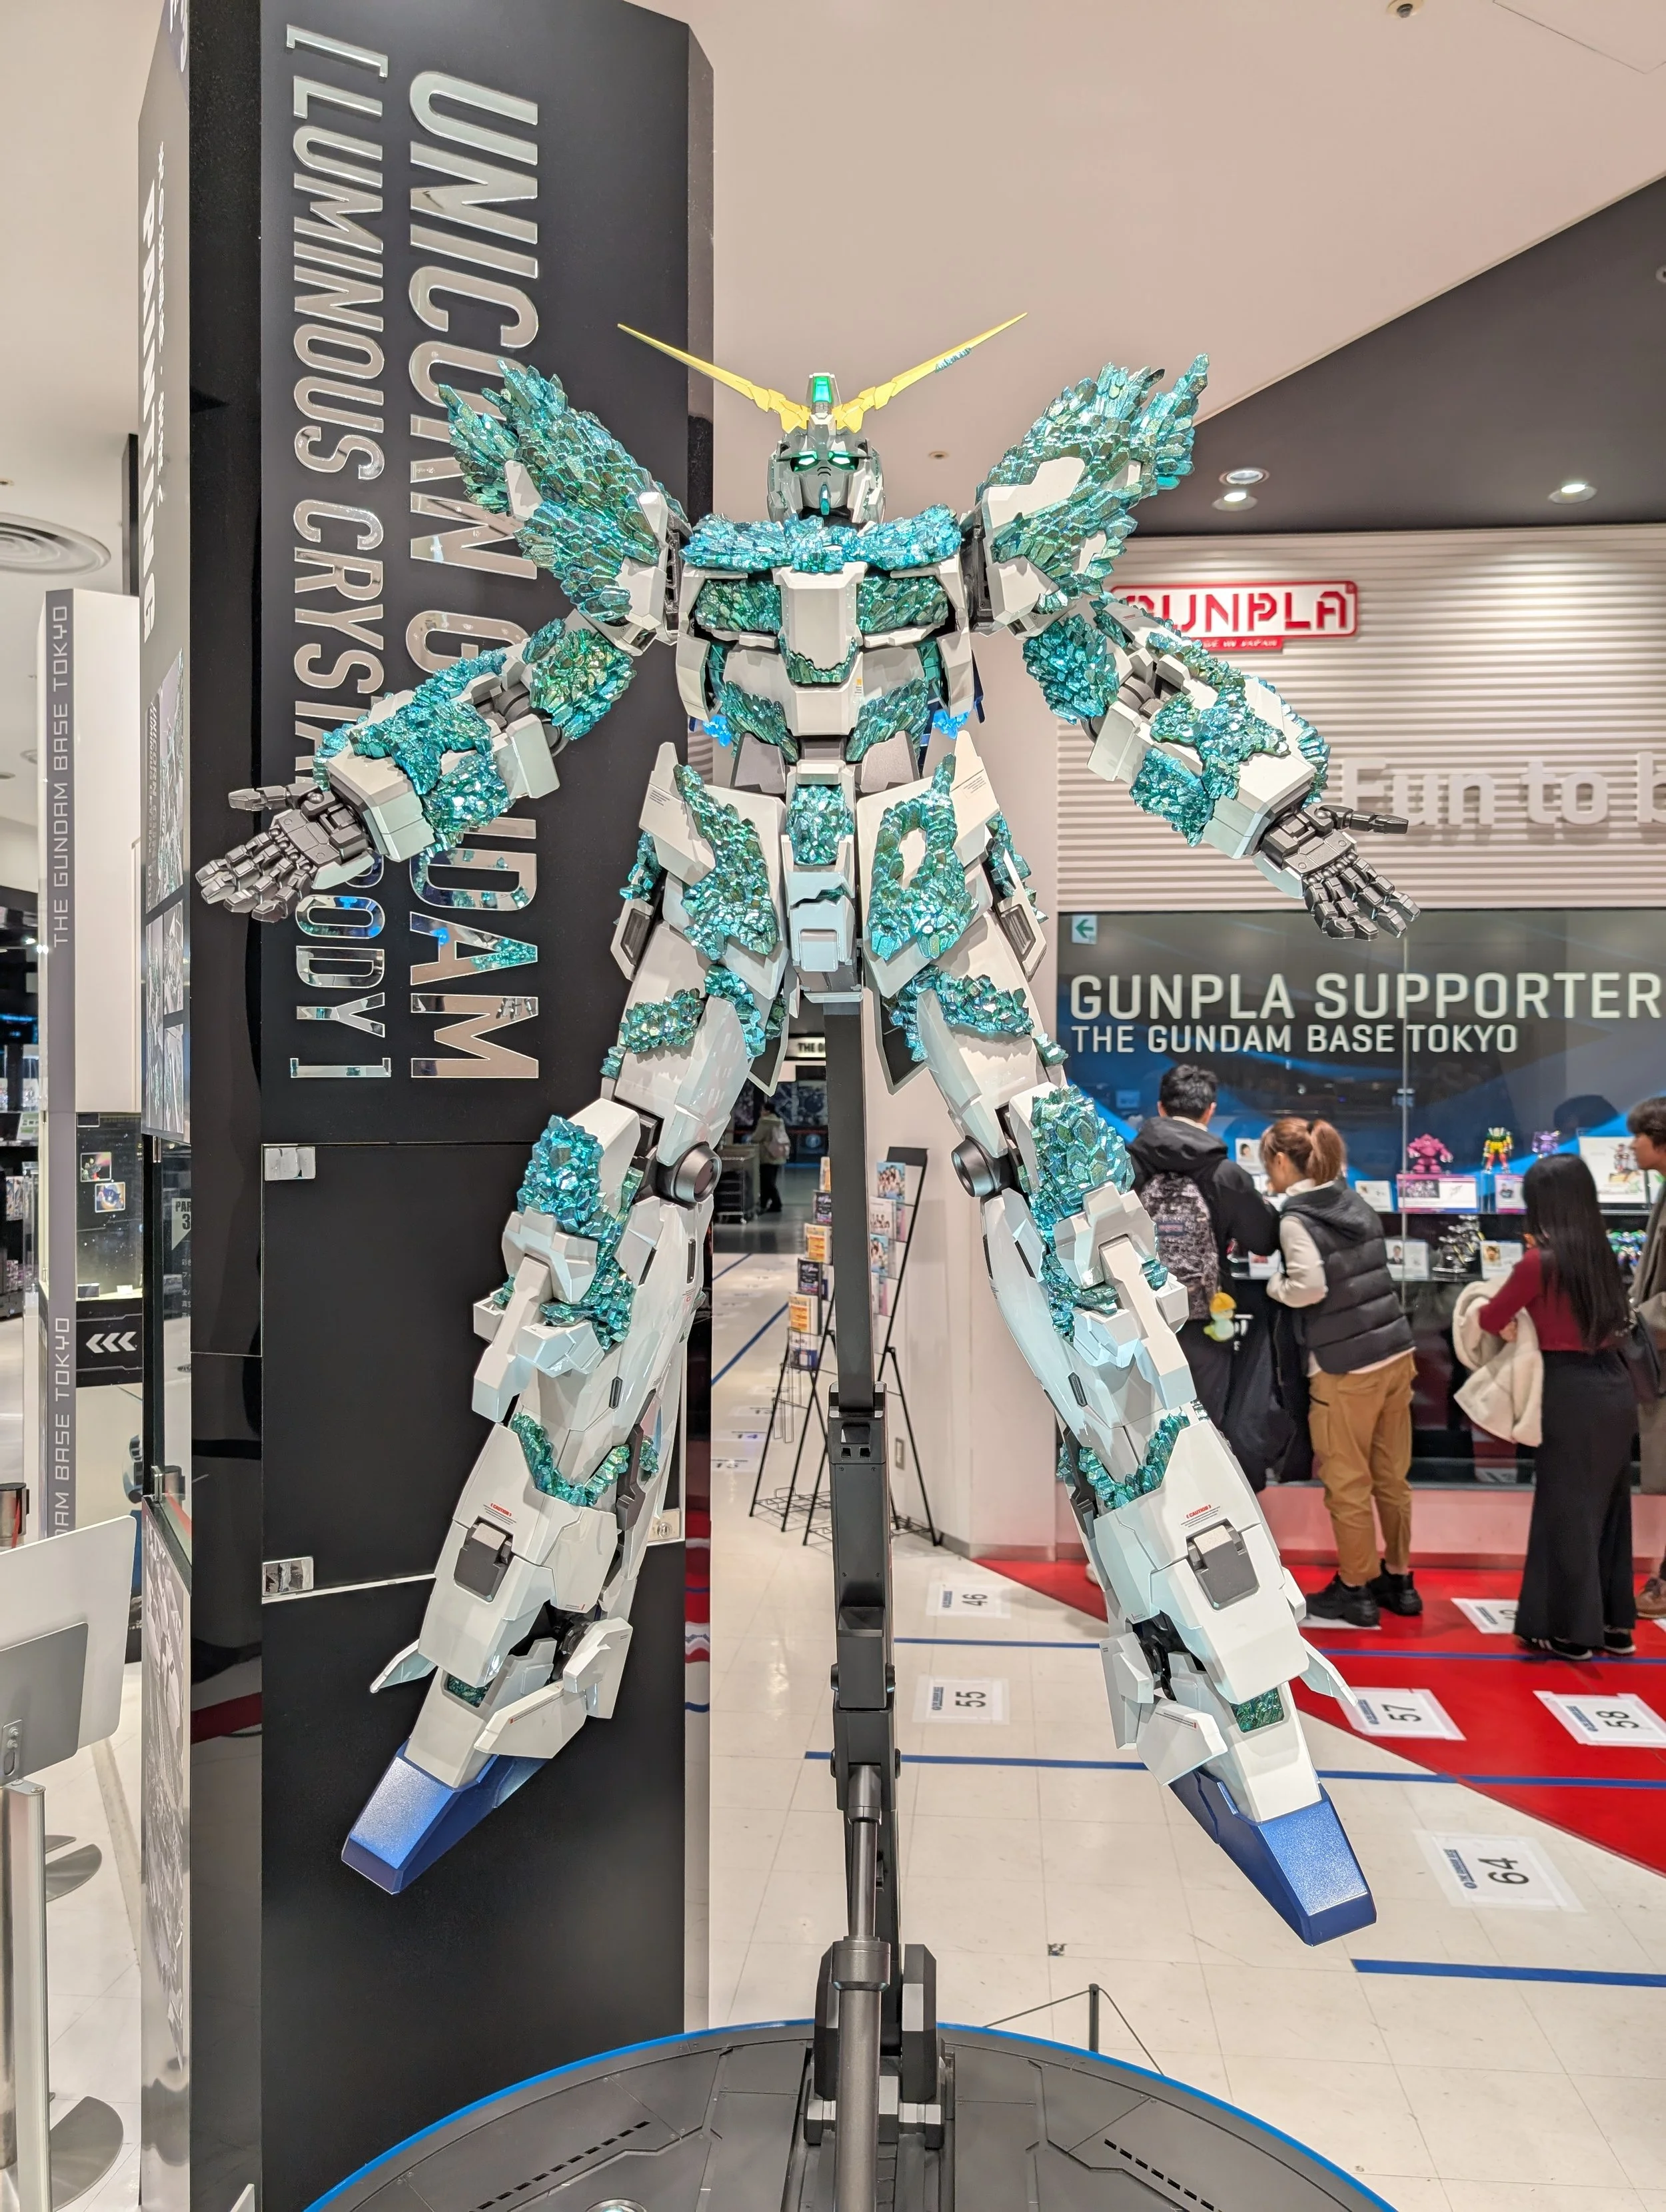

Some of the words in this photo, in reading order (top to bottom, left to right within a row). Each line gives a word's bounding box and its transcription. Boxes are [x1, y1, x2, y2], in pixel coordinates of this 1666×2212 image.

[293, 75, 385, 481] LUMINOUS
[143, 179, 156, 644] PAINTING
[53, 606, 68, 692] TOKYO
[293, 499, 385, 784] CRYST
[53, 704, 68, 770] BASE
[1342, 757, 1495, 826] Fun
[1521, 760, 1608, 825] to
[53, 783, 68, 887] GUNDAM
[406, 610, 538, 1078] GDAM
[53, 899, 68, 947] THE
[1071, 973, 1295, 1020] GUNPLA
[1315, 972, 1662, 1020] SUPPORTER
[798, 1043, 815, 1052] THE
[1071, 1025, 1135, 1053] THE
[1148, 1024, 1291, 1053] GUNDAM
[1307, 1024, 1395, 1053] BASE
[1407, 1024, 1518, 1053] TOKYO
[182, 1213, 191, 1230] 3
[55, 1317, 69, 1402] TOKYO
[55, 1414, 69, 1480] BASE
[962, 1594, 988, 1606] 46
[955, 1691, 987, 1708] 55
[1381, 1704, 1422, 1722] 57
[1595, 1710, 1640, 1729] 58
[1477, 1858, 1530, 1885] 64
